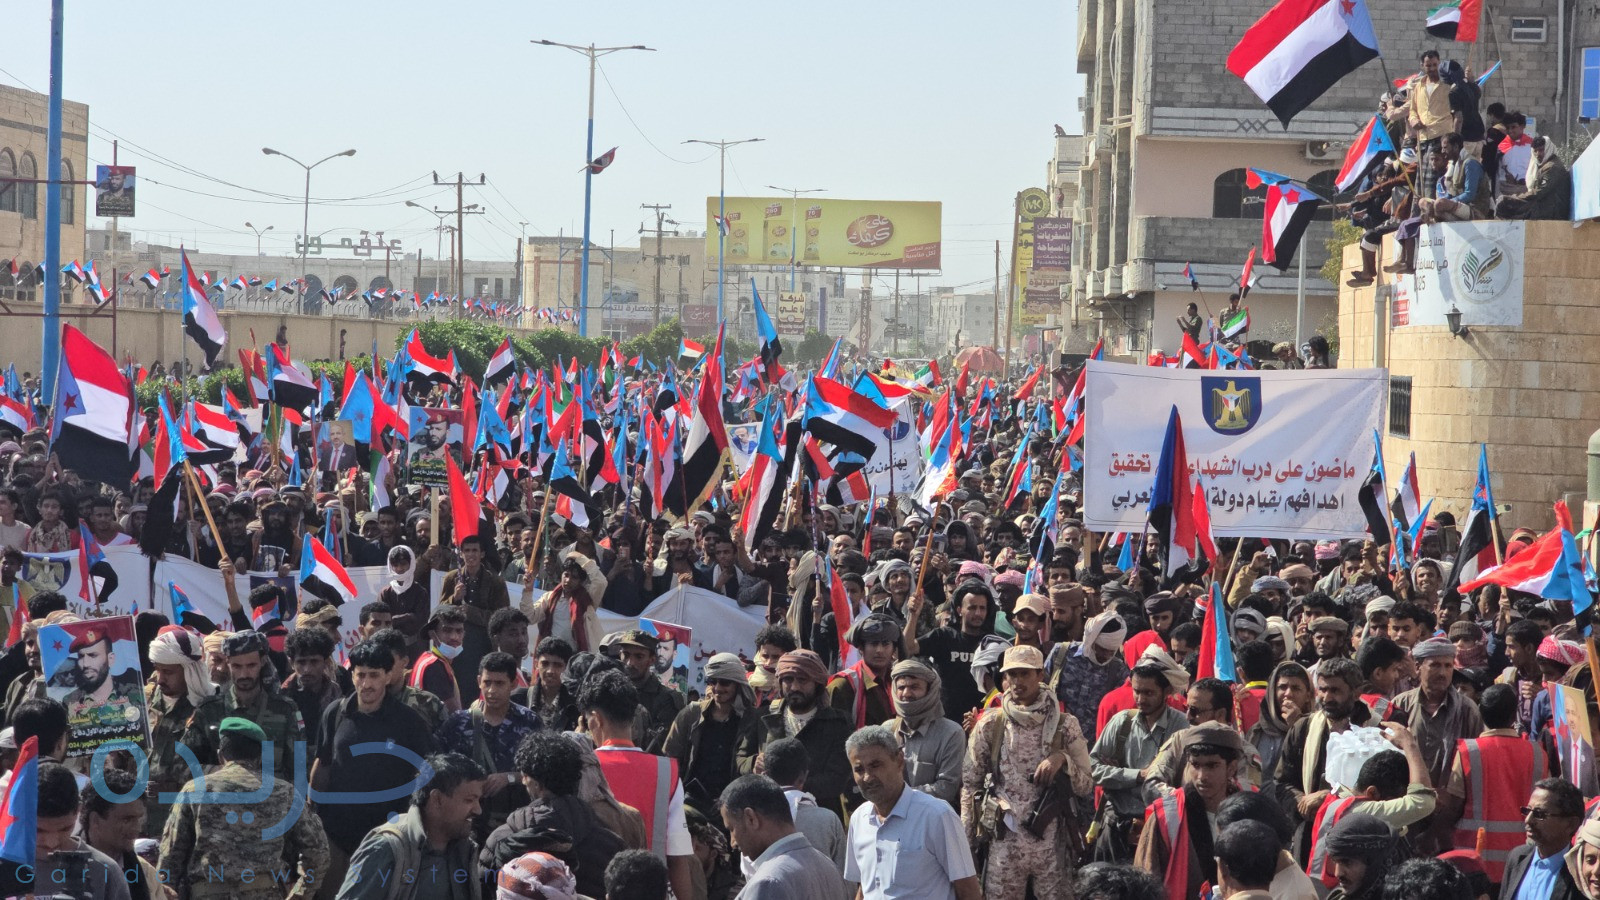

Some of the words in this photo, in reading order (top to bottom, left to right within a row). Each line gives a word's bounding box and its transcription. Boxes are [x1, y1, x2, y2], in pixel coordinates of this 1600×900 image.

[1025, 199, 1041, 212] MK
[780, 293, 805, 304] شركة
[1108, 453, 1151, 477] تحقيق
[1188, 455, 1241, 479] الشهداء
[1242, 461, 1272, 483] درب
[1275, 459, 1303, 483] على
[1305, 459, 1356, 483] ماضون
[1212, 487, 1244, 512] دولة
[1246, 490, 1282, 514] بقيام
